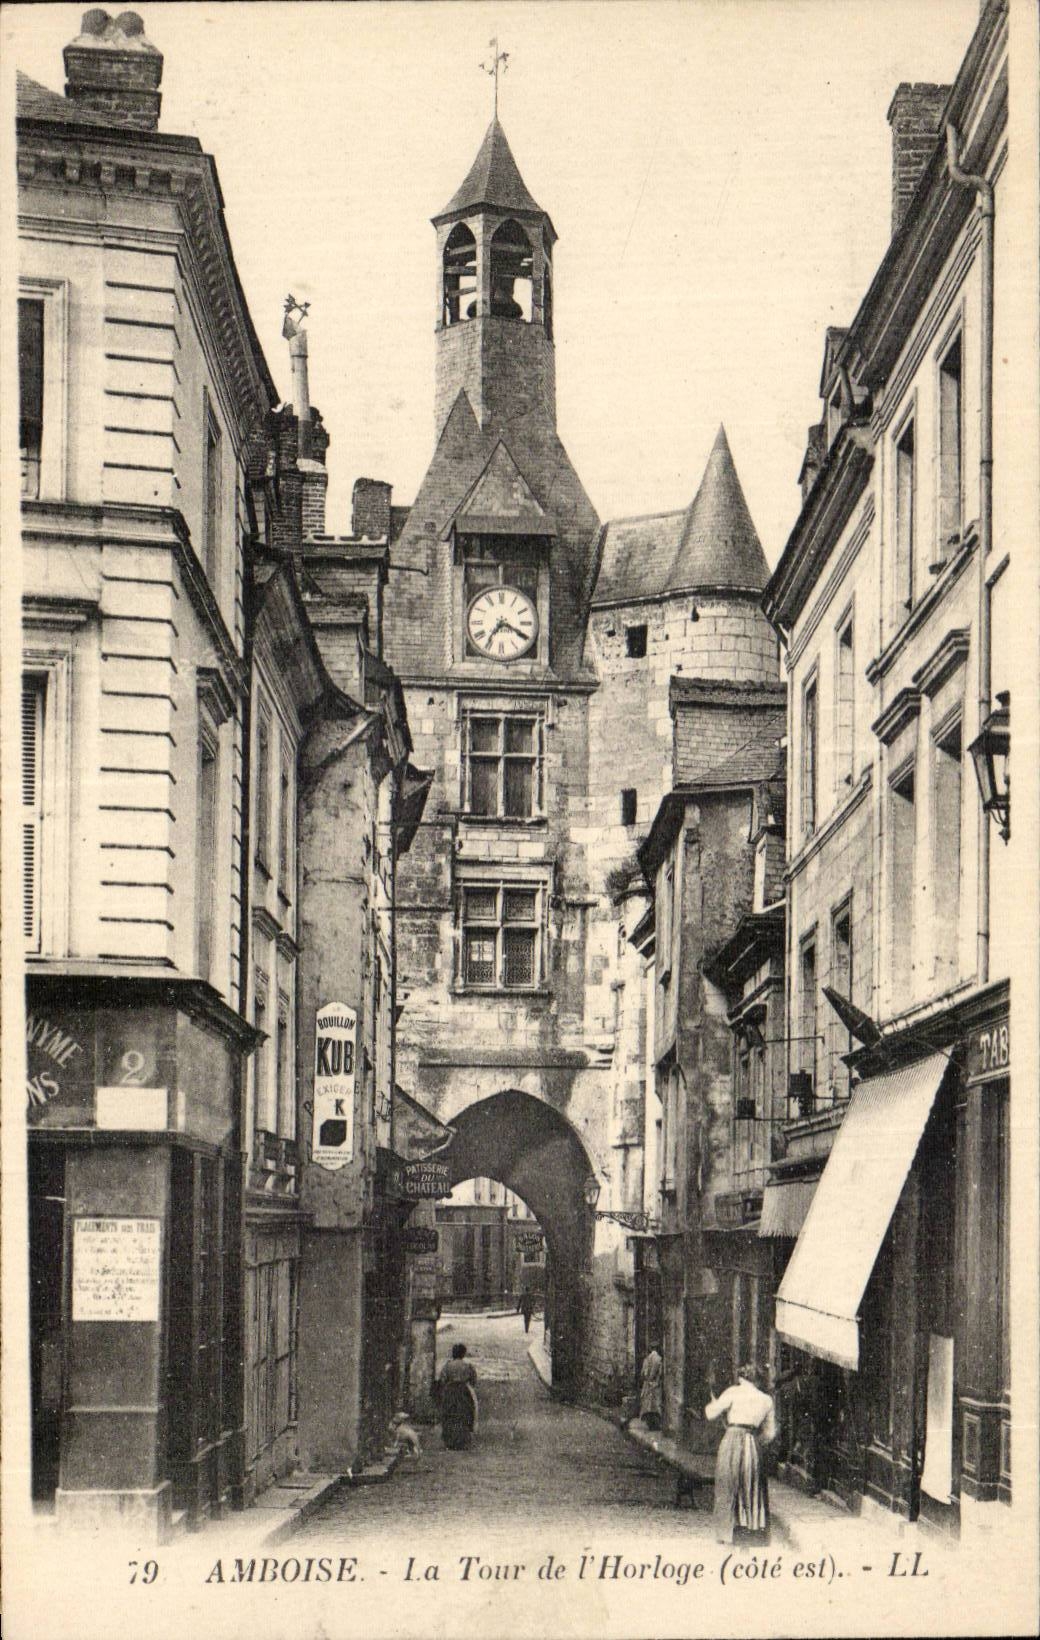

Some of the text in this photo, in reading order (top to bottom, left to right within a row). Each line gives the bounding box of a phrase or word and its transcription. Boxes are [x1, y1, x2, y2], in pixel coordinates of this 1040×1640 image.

[317, 1016, 356, 1030] BOUILLON
[317, 1036, 354, 1077] KUB
[980, 1025, 1008, 1070] TAB
[121, 1050, 147, 1086] 2
[335, 1098, 345, 1116] K
[406, 1163, 449, 1176] PATISSERIE
[421, 1174, 434, 1182] DU
